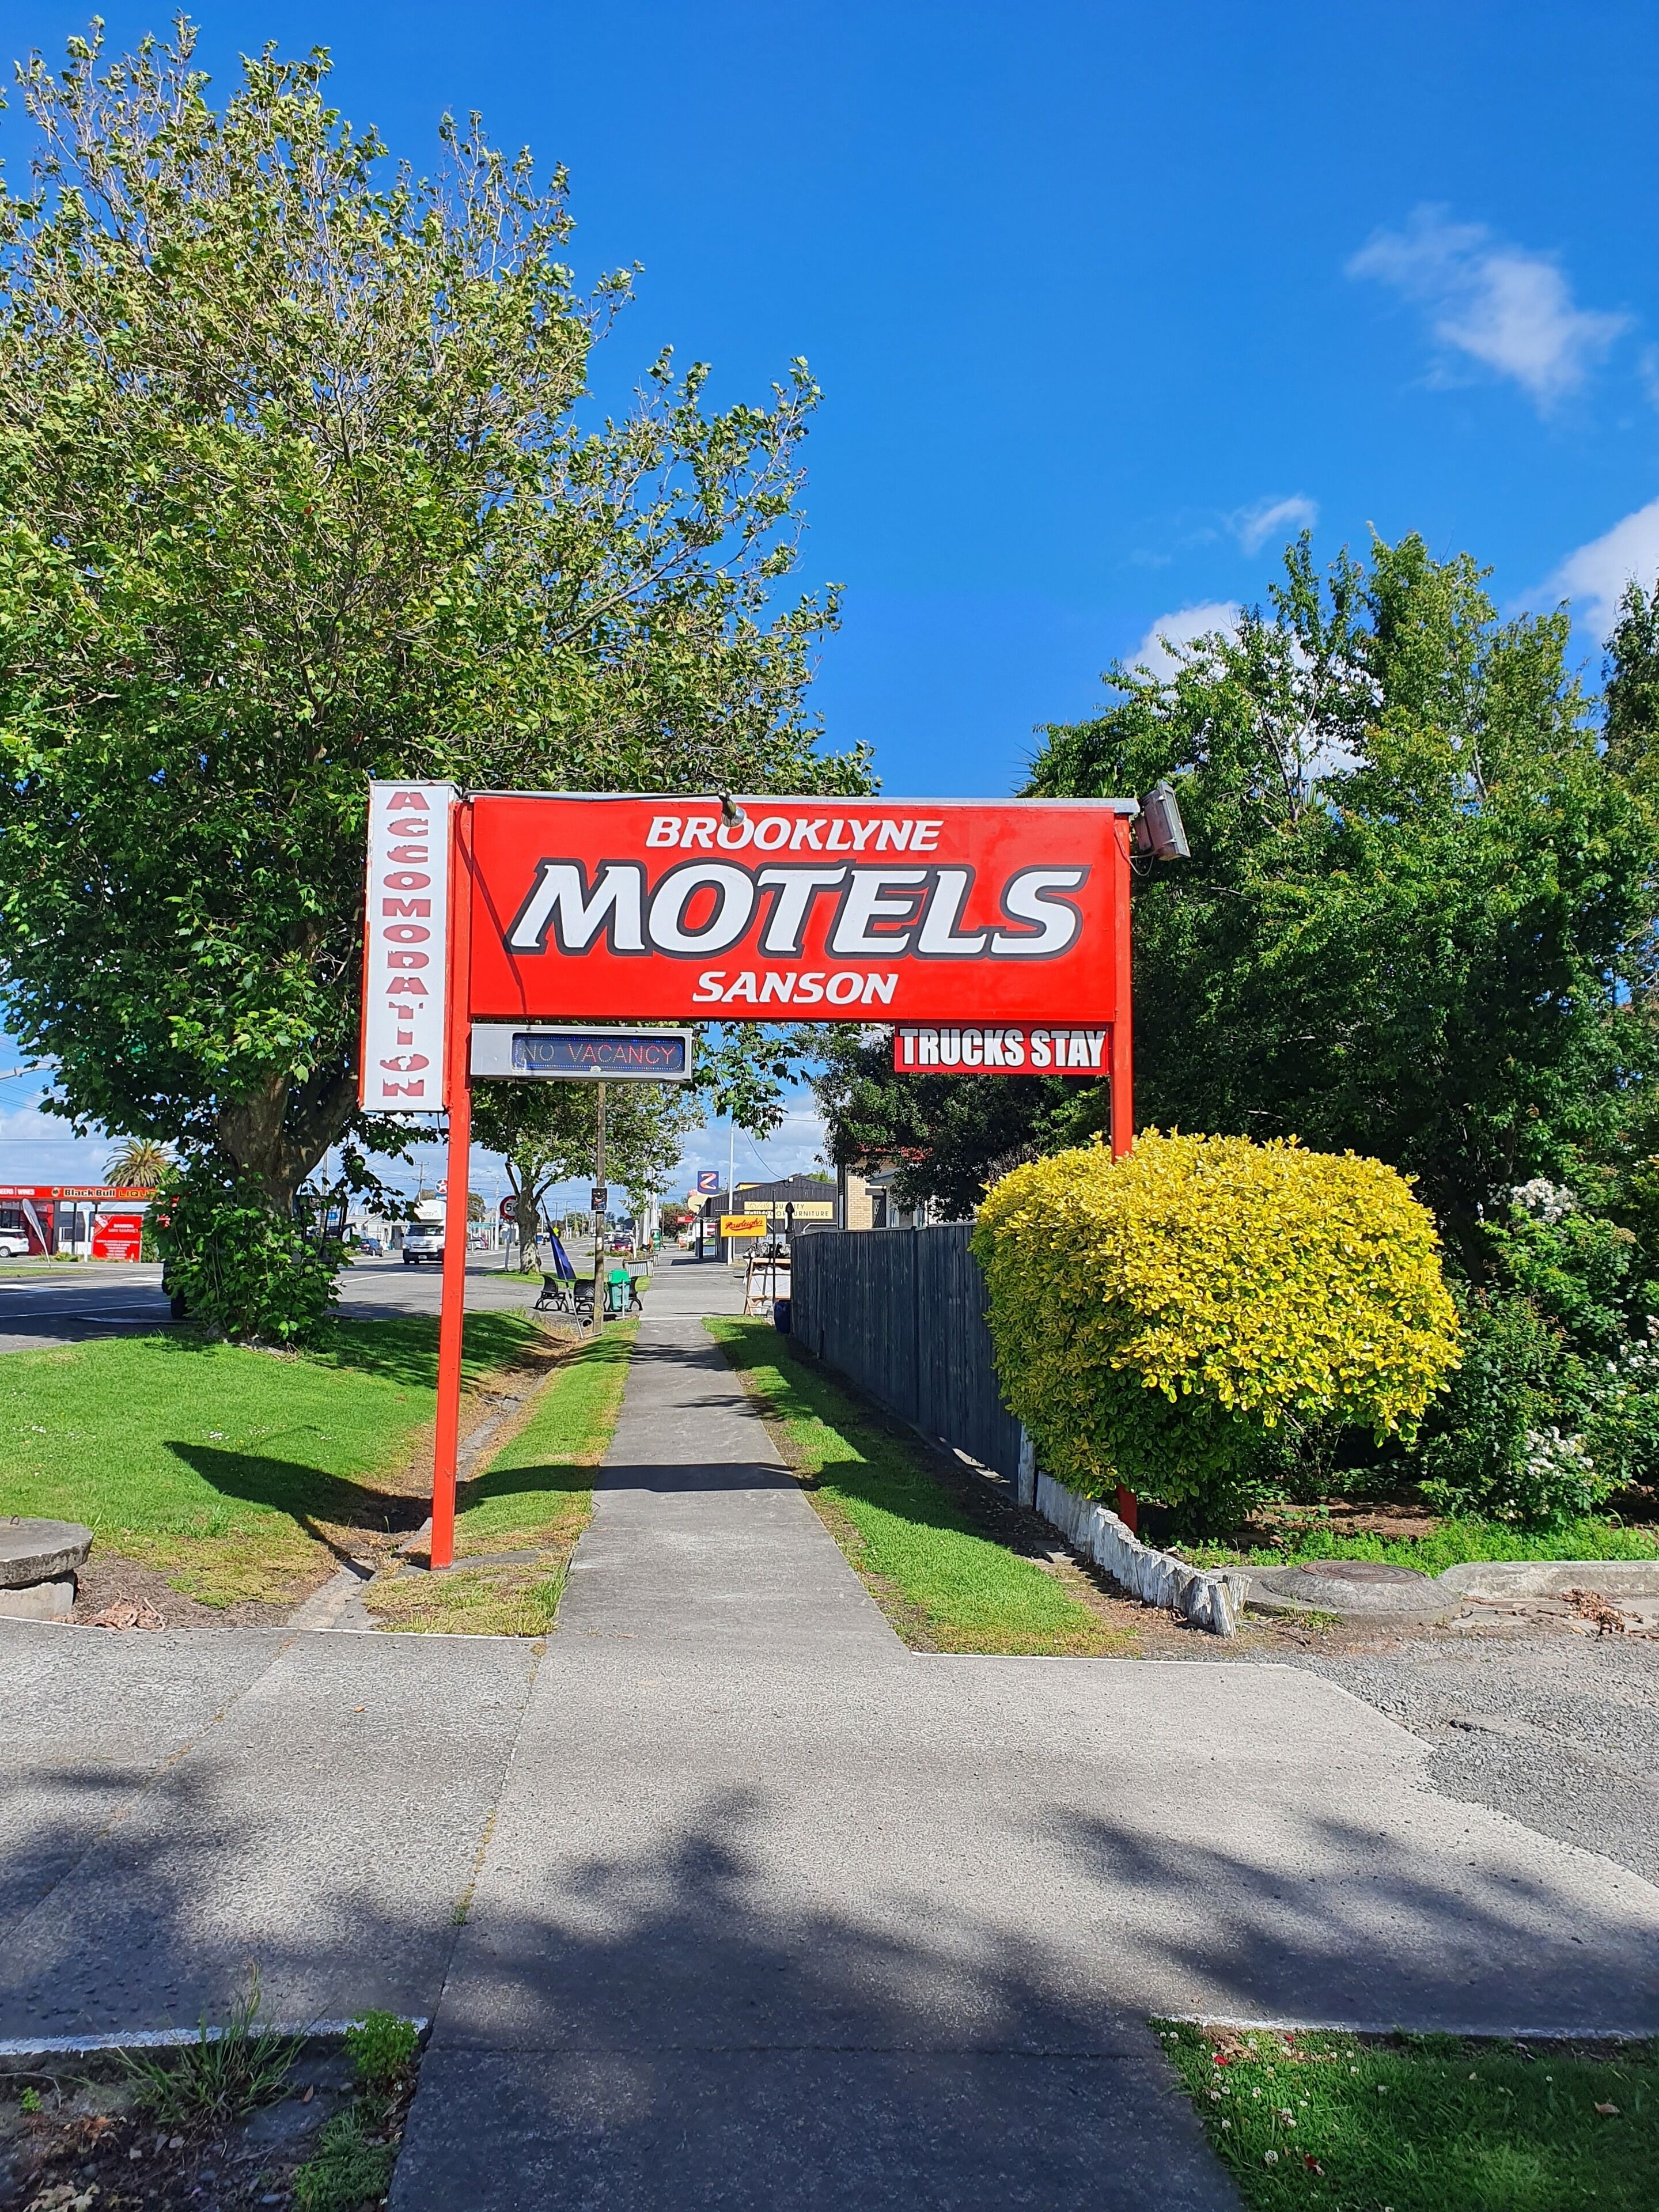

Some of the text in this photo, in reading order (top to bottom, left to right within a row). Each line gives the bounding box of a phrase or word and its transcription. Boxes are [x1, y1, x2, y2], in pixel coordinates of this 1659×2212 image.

[646, 816, 944, 851] BROOKLYNE
[510, 863, 1082, 954] MOTELS
[381, 792, 431, 1097] ACCOMODATION
[692, 971, 899, 1005] SANSON
[522, 1043, 675, 1065] NO VACANCY
[899, 1028, 1105, 1067] TRUCKS STAY
[63, 1188, 152, 1198] Black Bull LIQU
